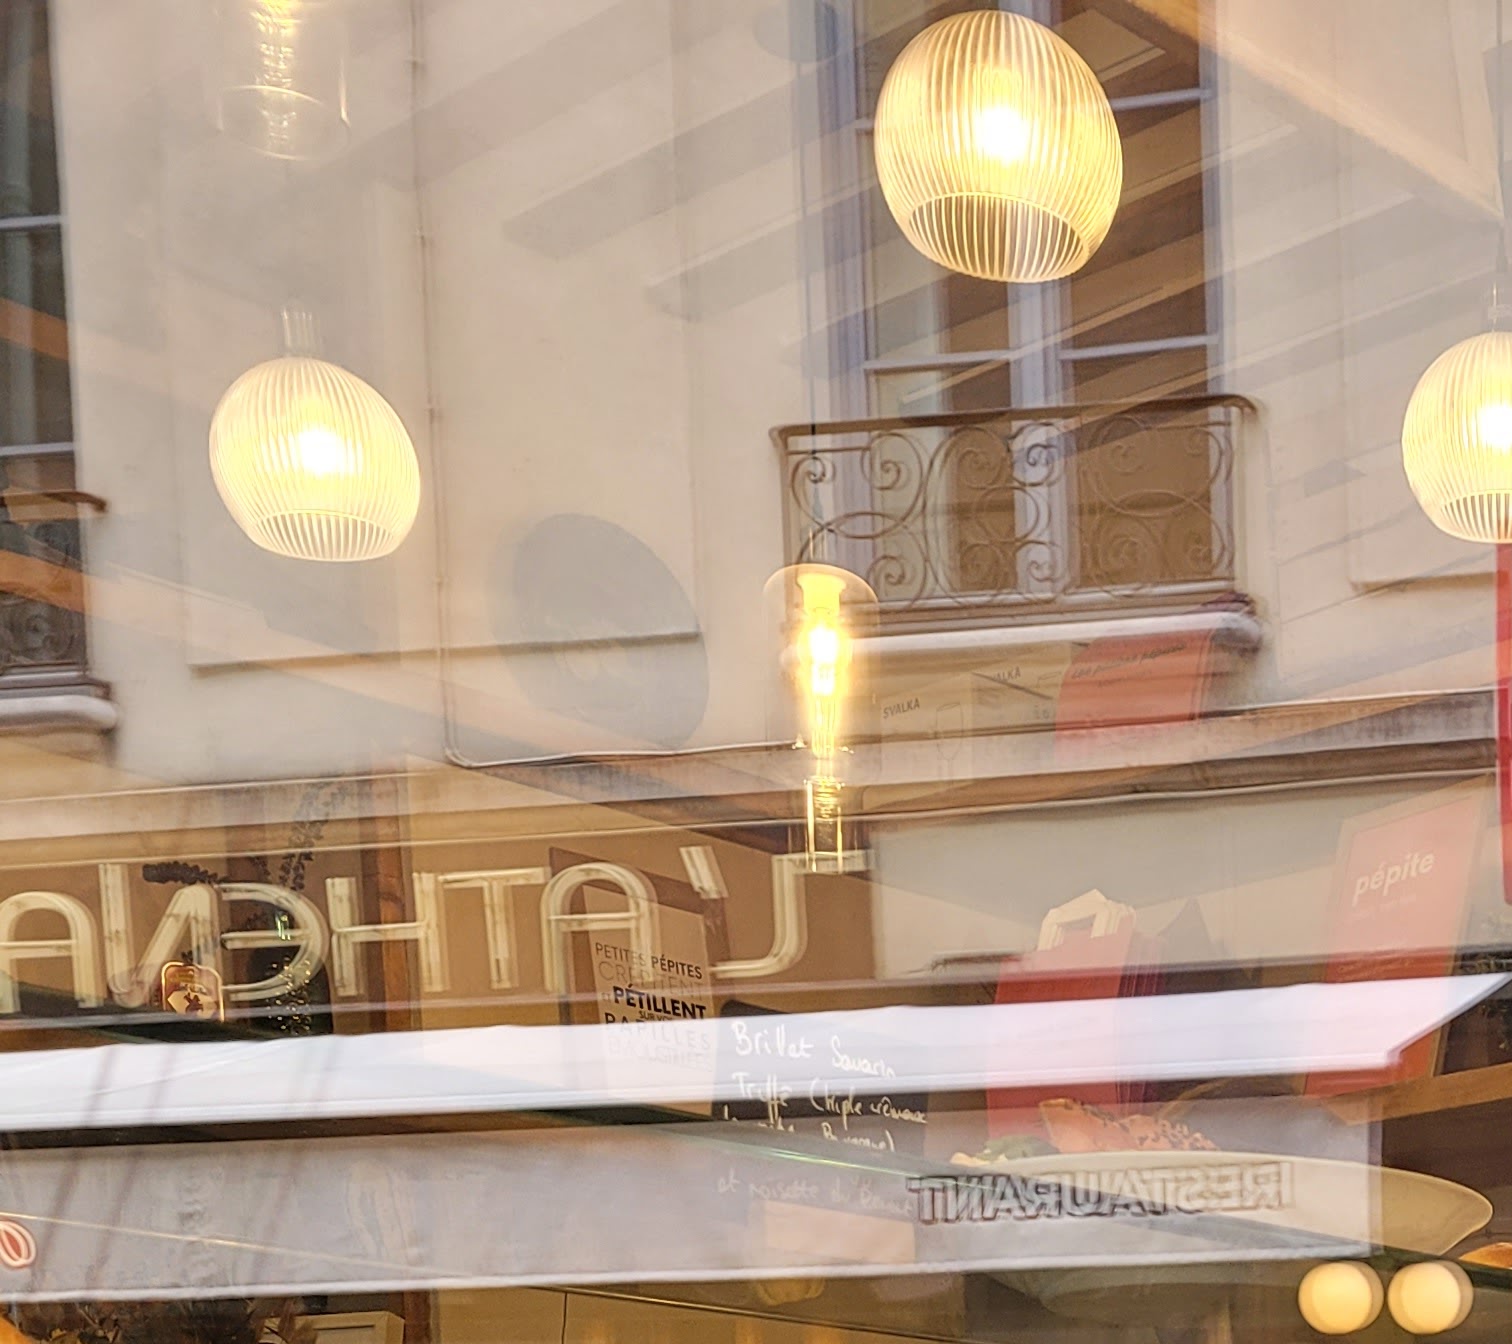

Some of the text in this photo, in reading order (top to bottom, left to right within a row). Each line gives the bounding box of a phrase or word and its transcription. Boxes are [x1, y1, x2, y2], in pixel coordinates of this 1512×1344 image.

[882, 698, 921, 719] SVALKA
[1352, 852, 1435, 907] pépite
[651, 954, 703, 980] PÉPITES
[612, 983, 707, 1020] PÉTILLENT
